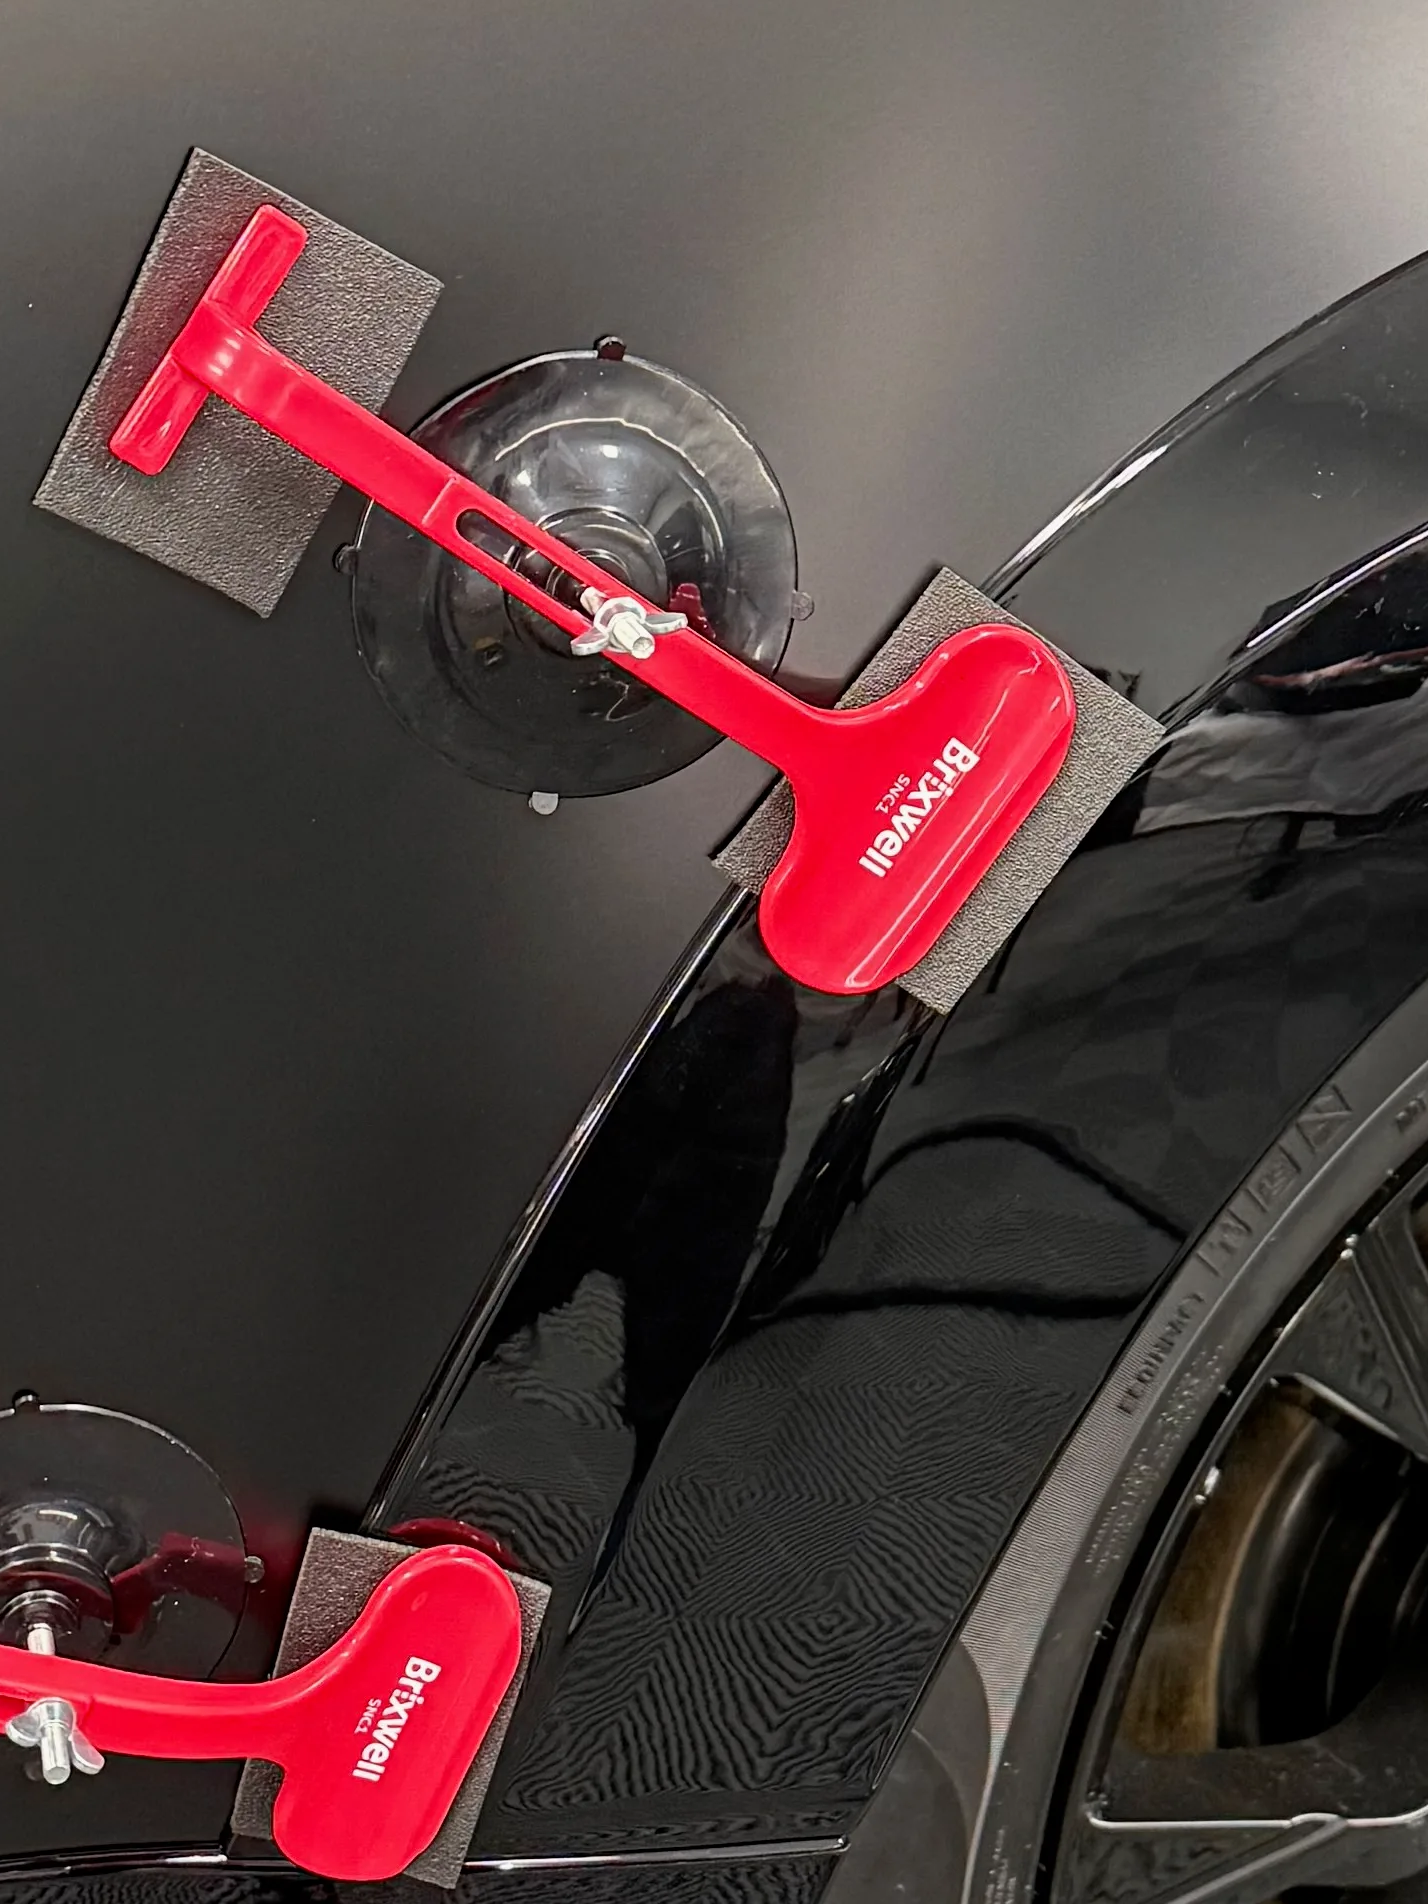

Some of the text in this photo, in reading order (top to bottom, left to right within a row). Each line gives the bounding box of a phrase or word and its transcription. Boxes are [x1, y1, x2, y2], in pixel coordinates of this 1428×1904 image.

[859, 738, 980, 877] Brixwell
[875, 773, 911, 813] SNC1
[353, 1657, 442, 1782] Brixwell
[355, 1699, 382, 1734] SNC1
